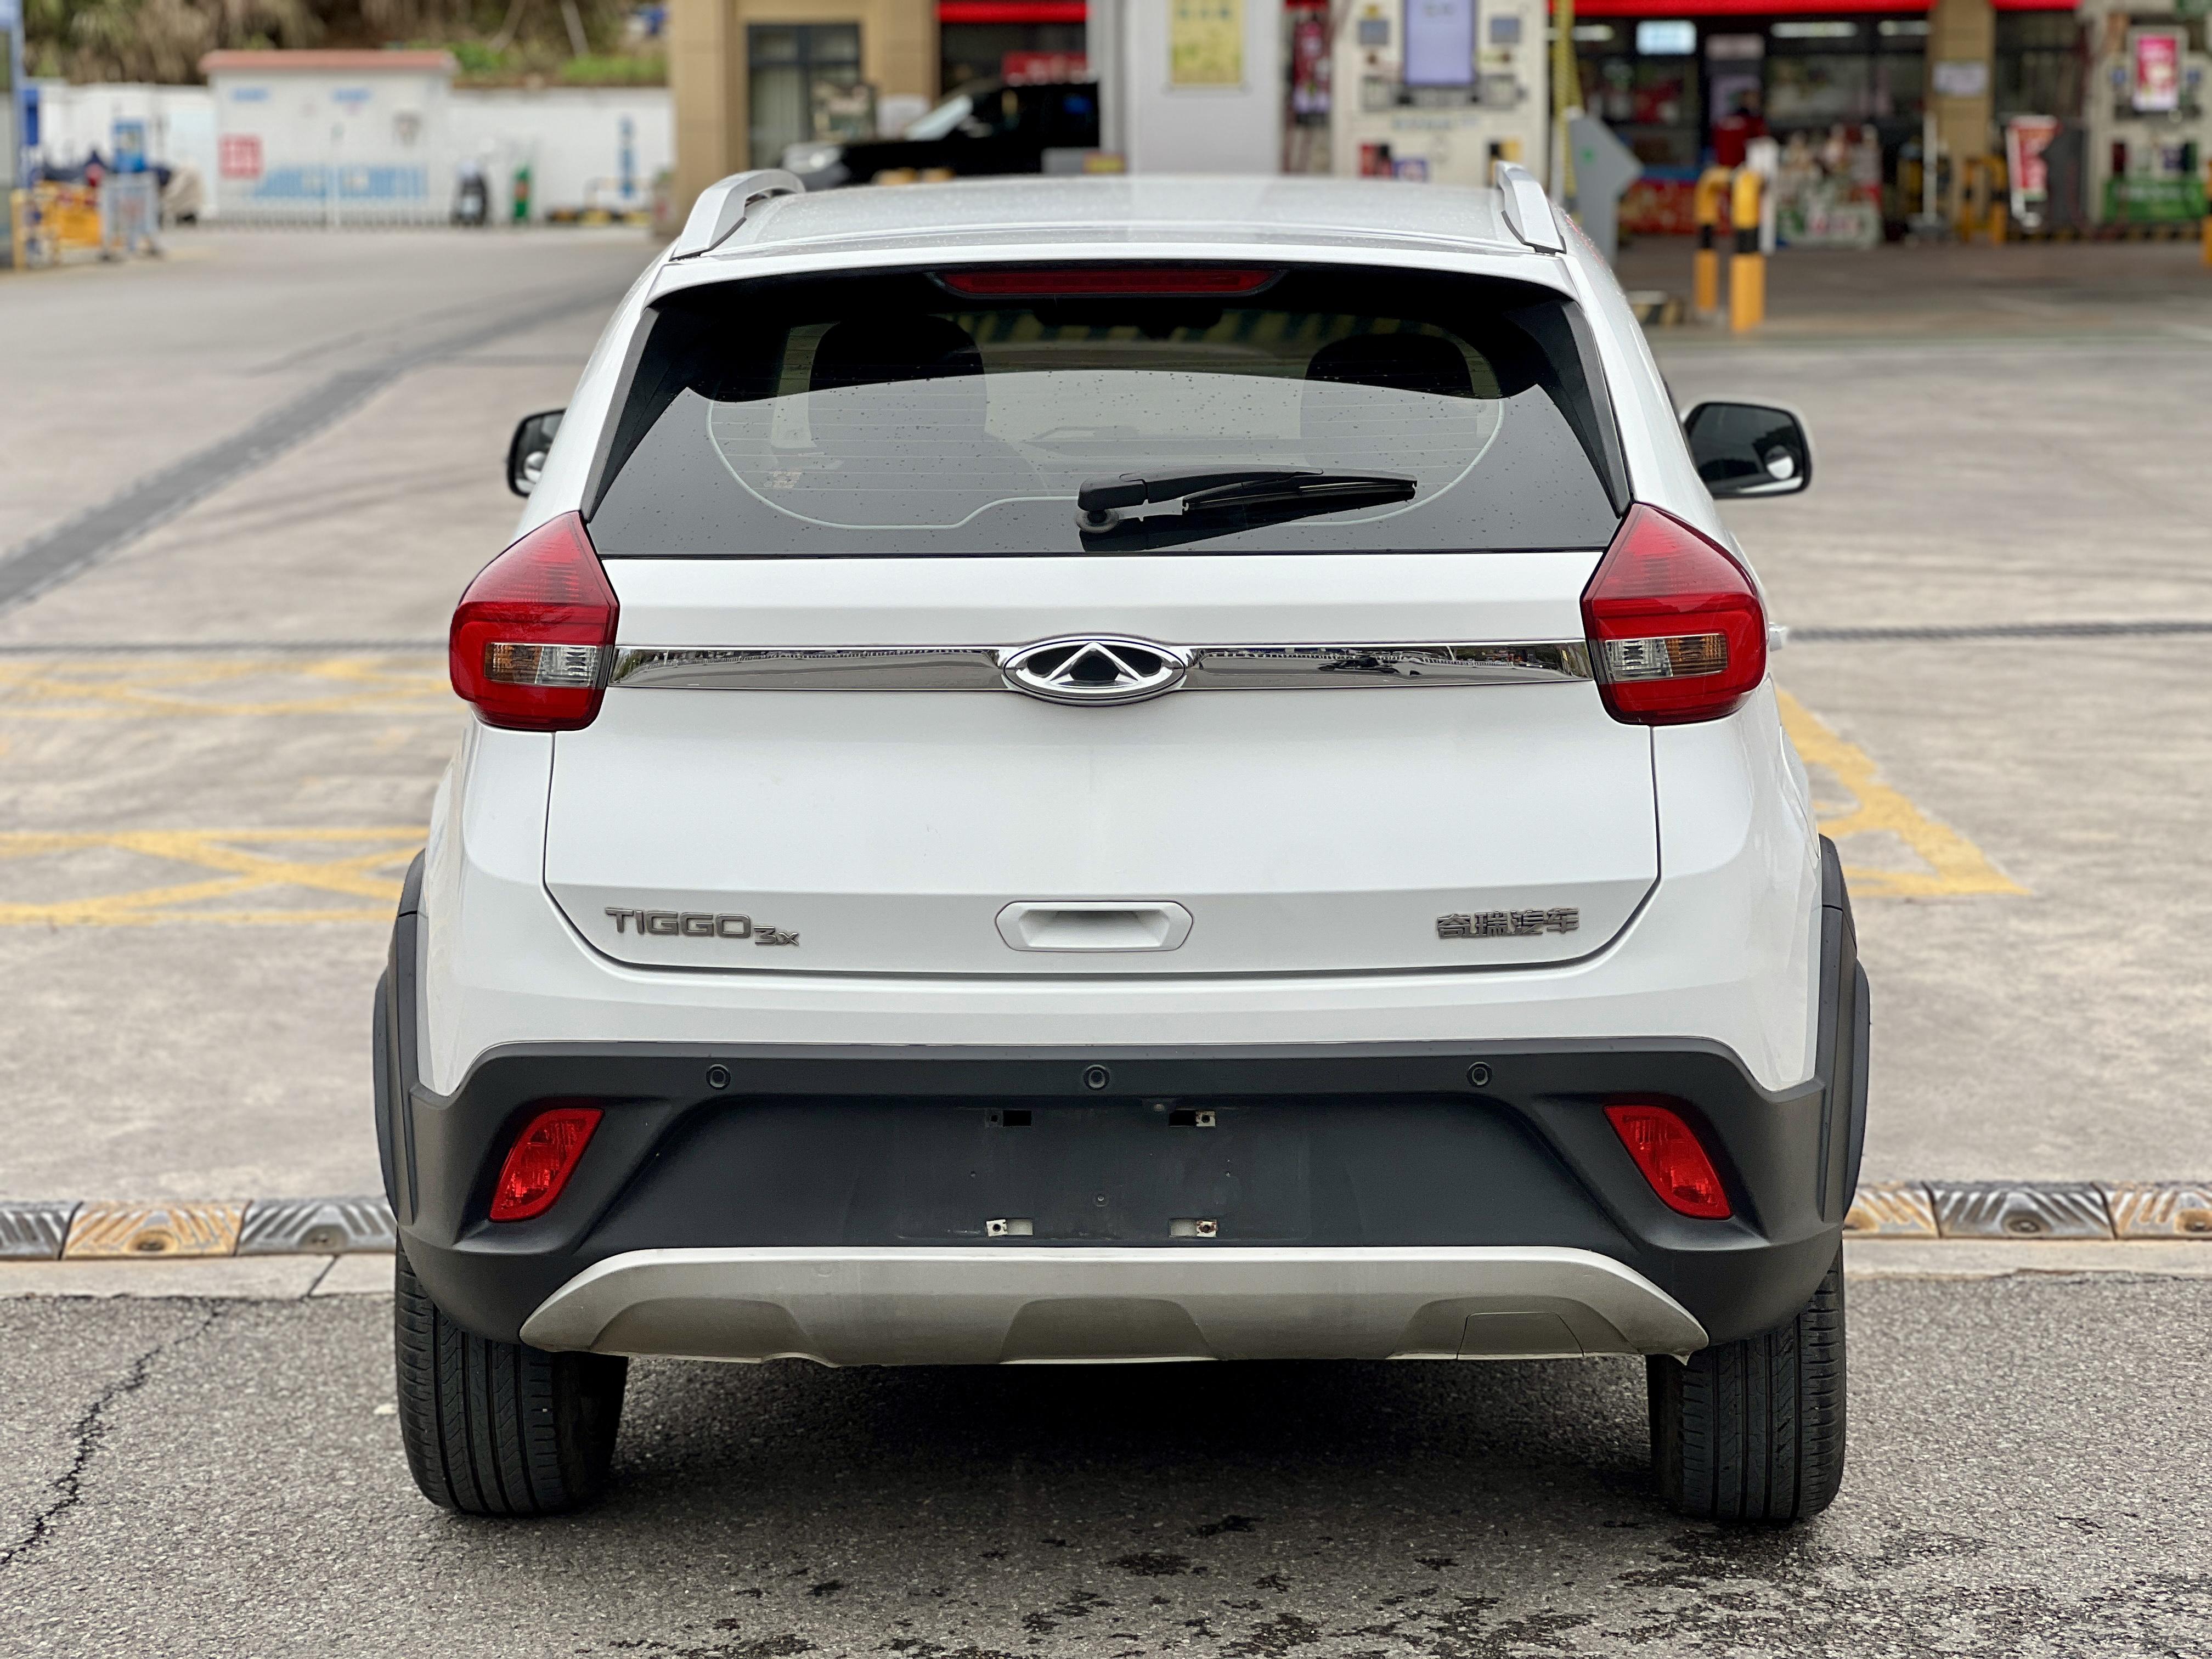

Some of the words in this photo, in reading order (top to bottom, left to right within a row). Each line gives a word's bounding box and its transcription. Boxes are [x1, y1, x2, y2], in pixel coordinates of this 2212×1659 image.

[605, 907, 751, 939] TIGGO
[1437, 908, 1579, 939] 奇瑞汽车
